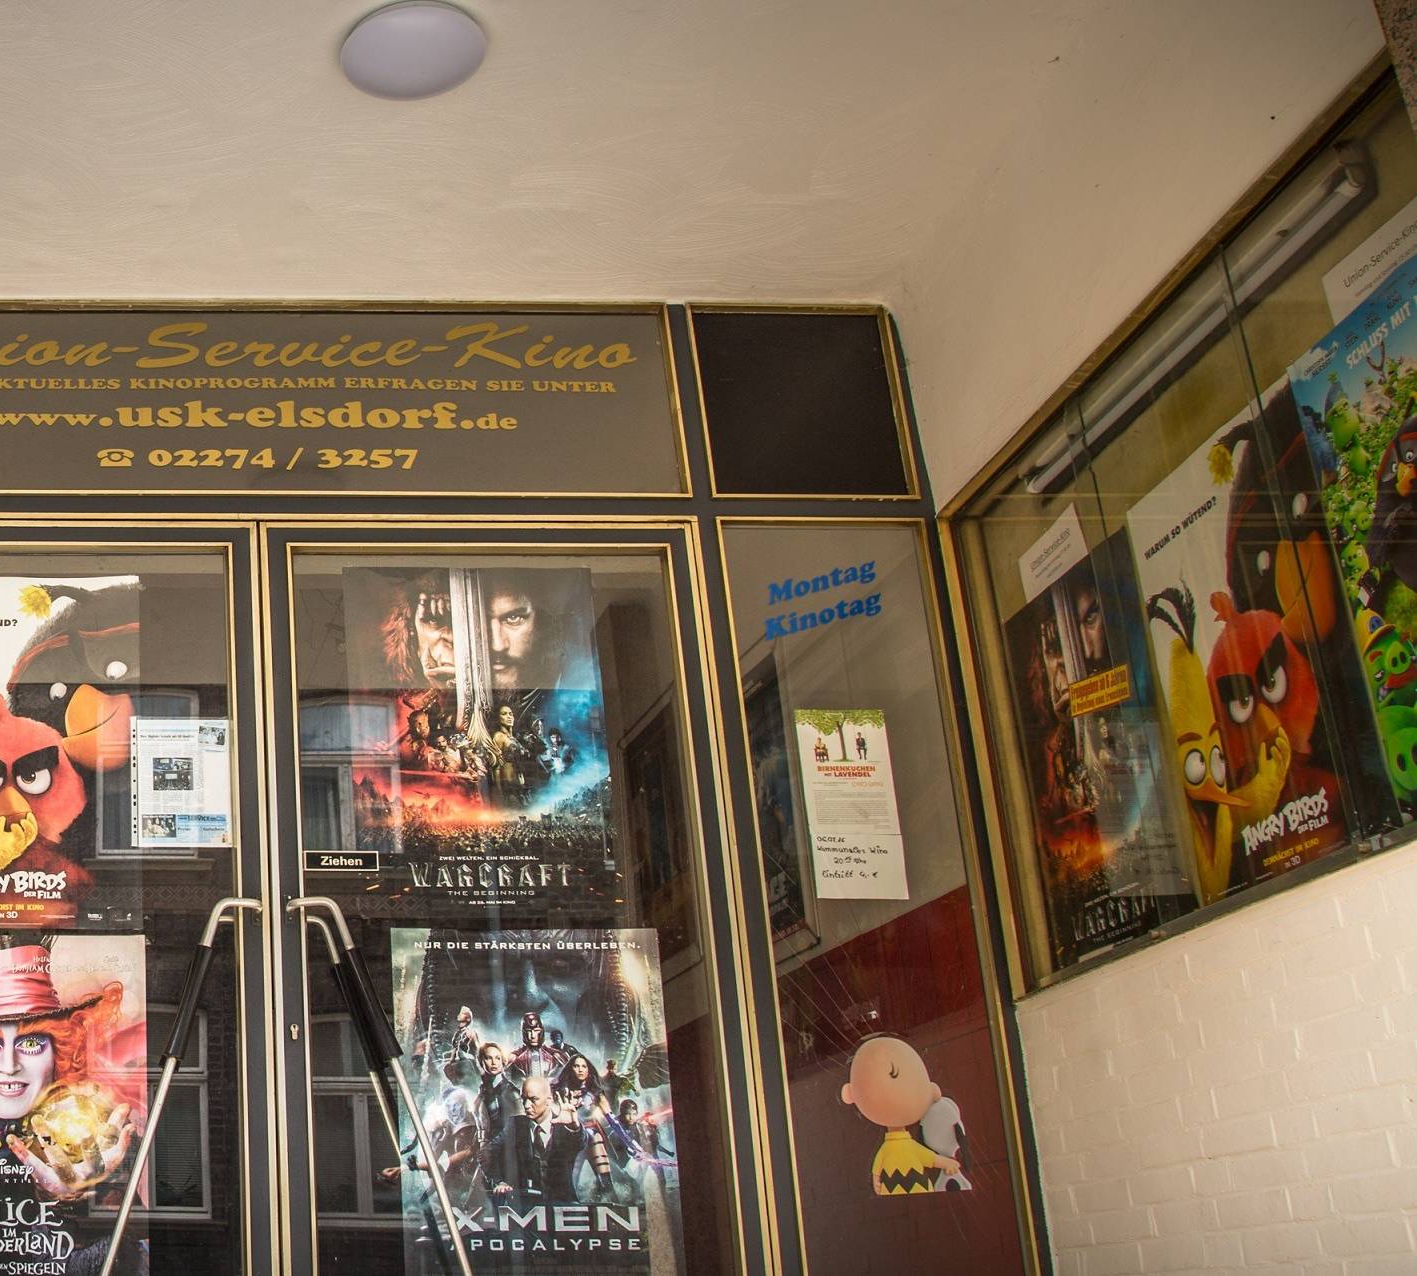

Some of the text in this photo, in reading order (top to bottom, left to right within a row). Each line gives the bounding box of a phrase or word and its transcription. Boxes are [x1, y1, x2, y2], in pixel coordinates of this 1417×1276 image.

[1346, 322, 1388, 369] SCHLUSS
[1390, 301, 1411, 330] MIT
[129, 376, 336, 390] KINOPROGRAMM
[345, 378, 478, 391] ERFRAGEN
[485, 380, 525, 392] SIE
[532, 380, 616, 393] UNTER
[148, 447, 276, 469] 02274
[317, 448, 418, 469] 3257
[1144, 496, 1217, 560] WARUM SO WÜTEND?
[768, 560, 876, 605] Montag
[764, 592, 882, 640] Kinotag
[1241, 787, 1329, 856] ANGRY BIRDS
[1308, 815, 1329, 831] FILM
[321, 856, 363, 866] Ziehen
[11, 871, 67, 893] BIRDS
[408, 862, 573, 888] WARCRAFT
[23, 890, 61, 899] DER FILM
[6, 911, 18, 919] 3D
[15, 903, 25, 911] IM
[26, 903, 45, 911] KINO
[414, 940, 641, 950] NUR DIE STÄRKSTEN ÜBERLEBEN.
[451, 1206, 640, 1232] X-MEN
[3, 1228, 16, 1238] IM
[450, 1238, 641, 1251] POCALYPSE
[7, 1261, 67, 1276] SPIEGELN
